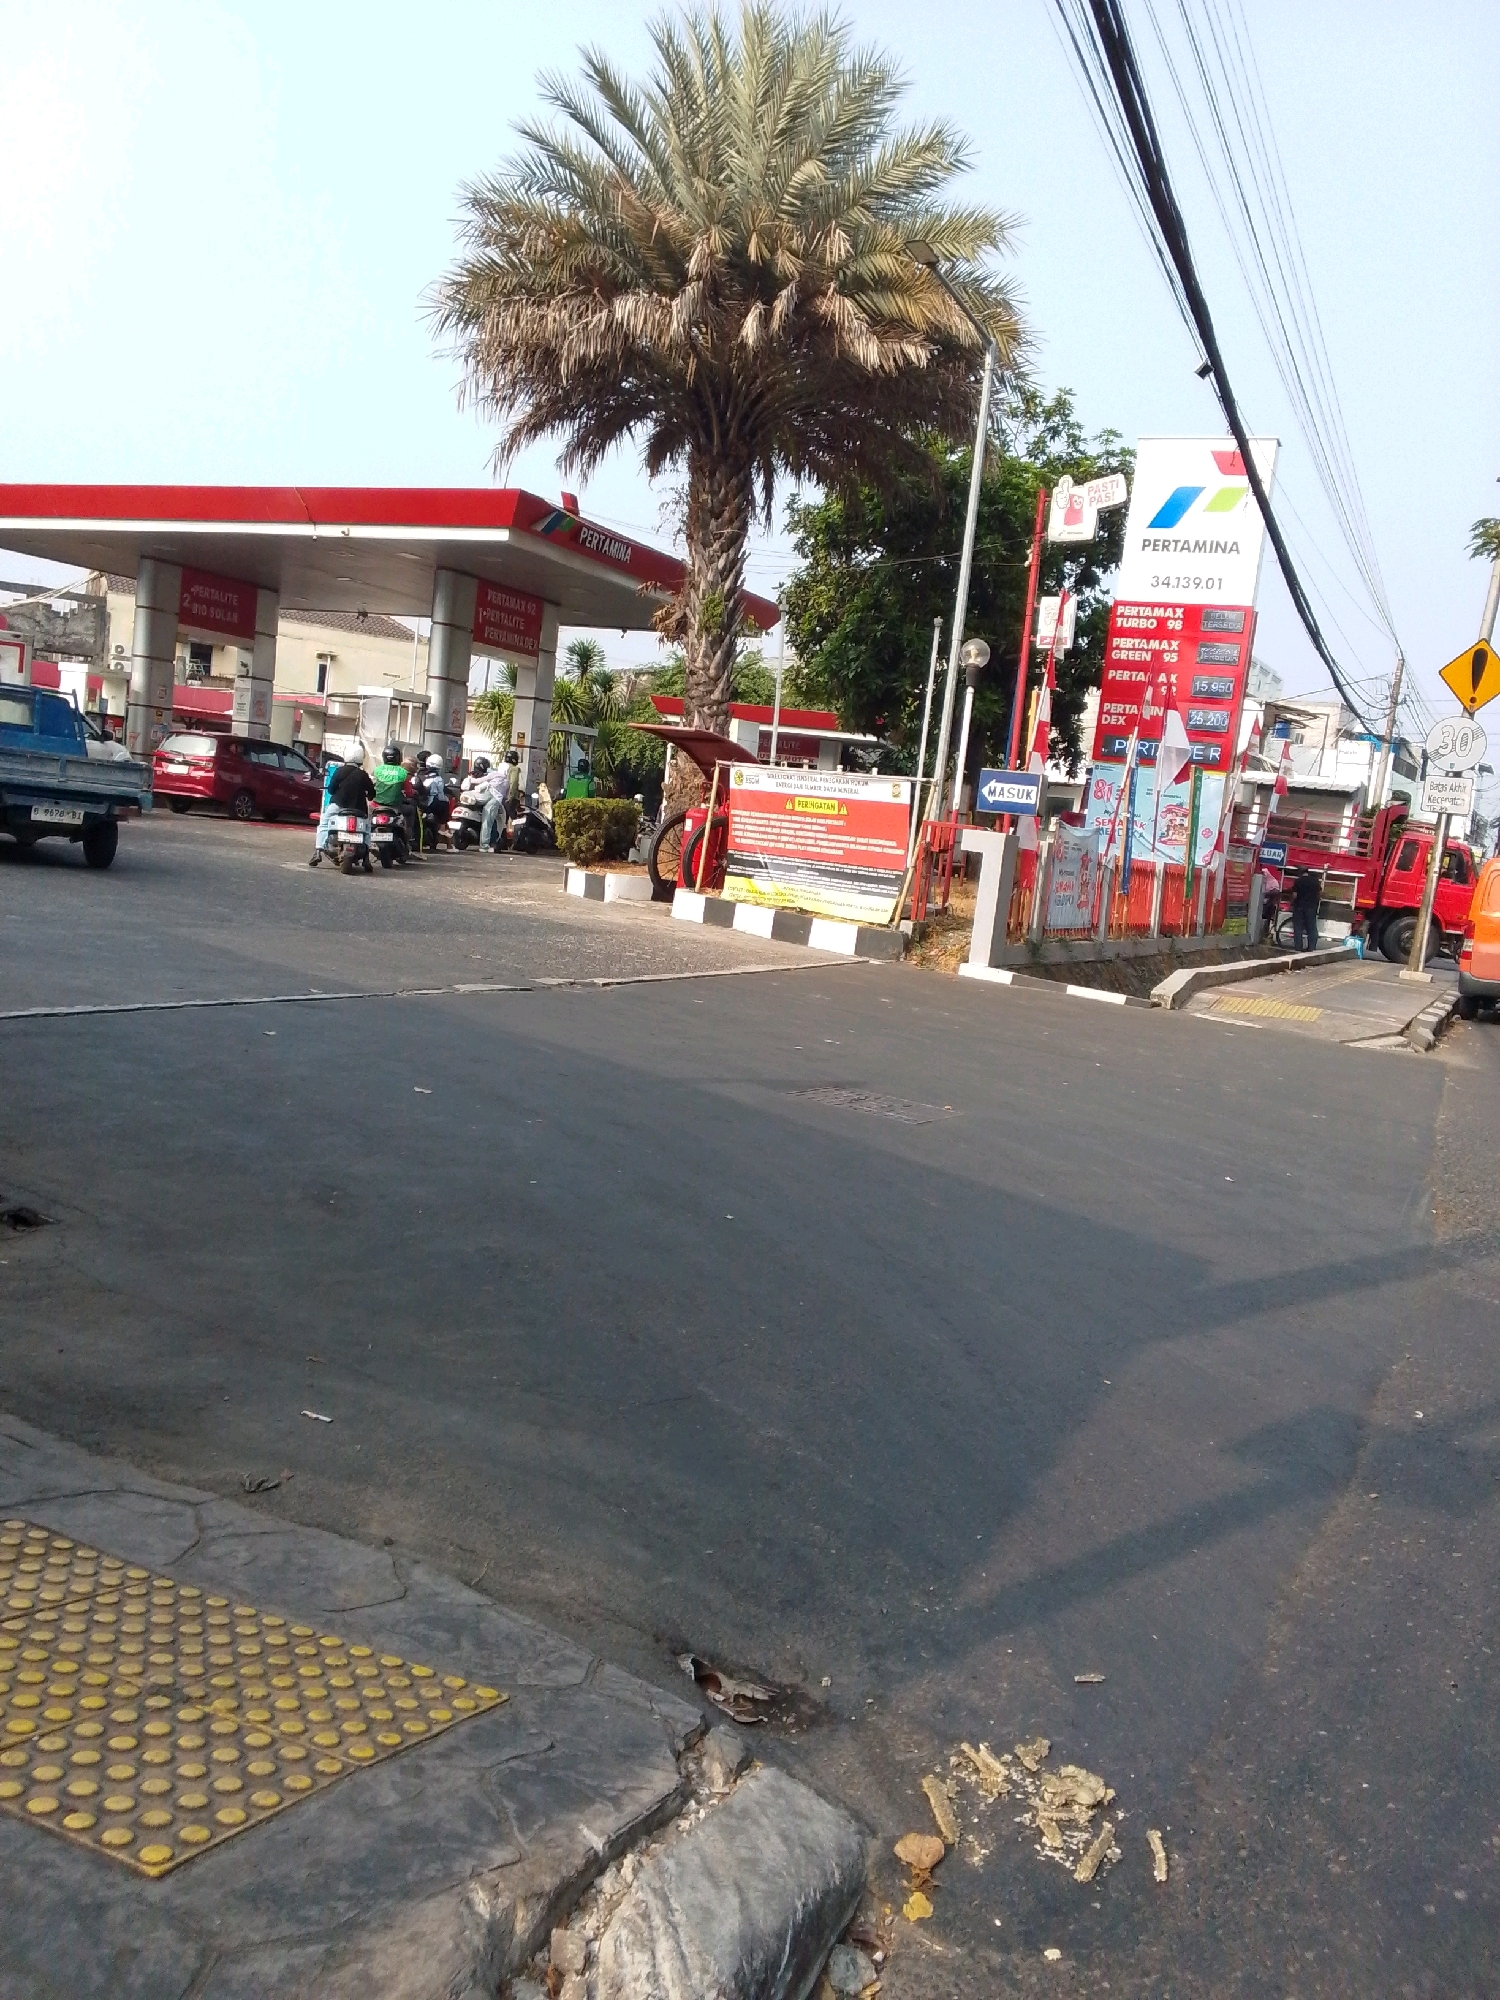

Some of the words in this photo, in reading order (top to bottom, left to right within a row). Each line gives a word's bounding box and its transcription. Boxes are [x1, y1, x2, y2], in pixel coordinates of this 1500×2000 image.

[1087, 478, 1119, 496] PASTI
[1088, 491, 1115, 507] PAS!
[579, 526, 632, 563] PERTAMINA
[1141, 539, 1240, 555] PERTAMINA
[1150, 575, 1223, 590] 34.139.01
[486, 607, 525, 630] PERTALITE
[1116, 605, 1185, 619] PERTAMAX
[1115, 617, 1158, 630] TURBO
[1166, 619, 1183, 631] 98
[1112, 637, 1181, 651] PERTAMAX
[1111, 649, 1152, 662] GREEN
[1163, 652, 1178, 663] 95
[1107, 669, 1178, 684] PERTAAX
[1194, 681, 1232, 693] 15.950
[1103, 703, 1165, 717] PERTAIN
[1101, 714, 1127, 726] DEX
[1438, 724, 1473, 757] 30
[987, 785, 1034, 800] MASUK
[797, 800, 836, 811] PERINGATAN
[1259, 850, 1283, 859] LUAR
